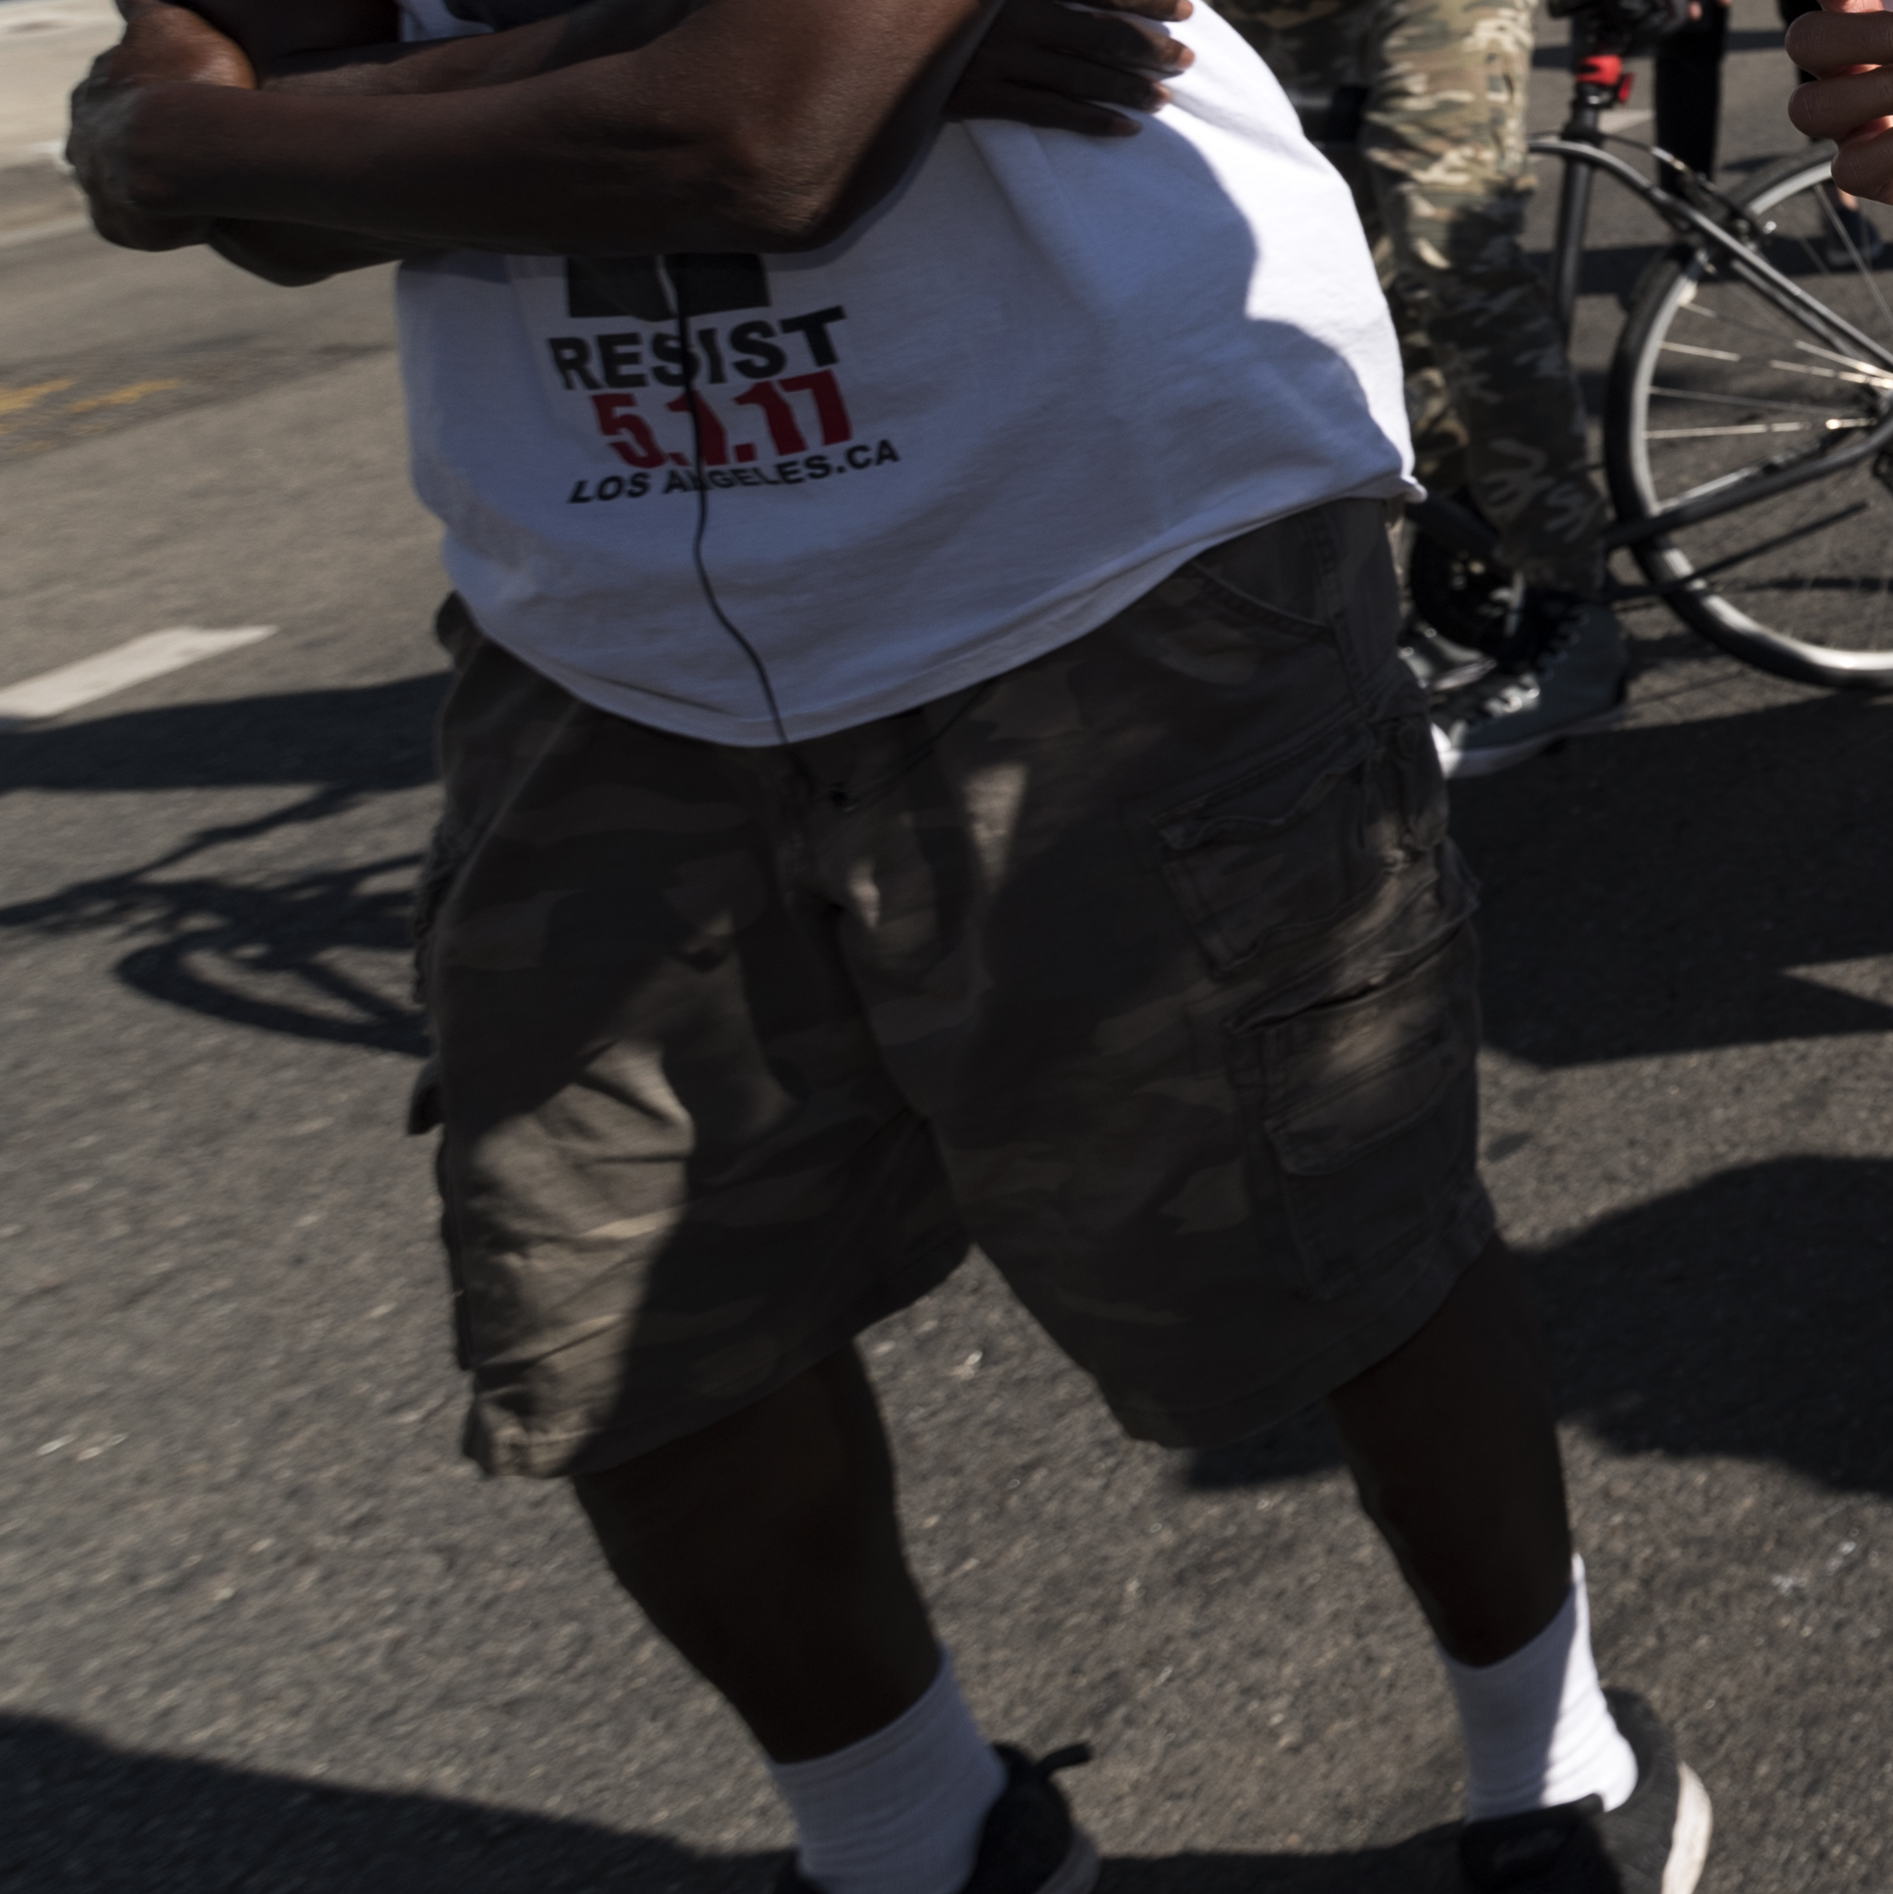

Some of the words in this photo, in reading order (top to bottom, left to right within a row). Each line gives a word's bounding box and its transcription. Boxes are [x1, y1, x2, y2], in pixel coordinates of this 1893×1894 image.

[546, 305, 848, 392] RESIST
[590, 368, 852, 469] 5.1.17
[567, 471, 650, 504] LOS
